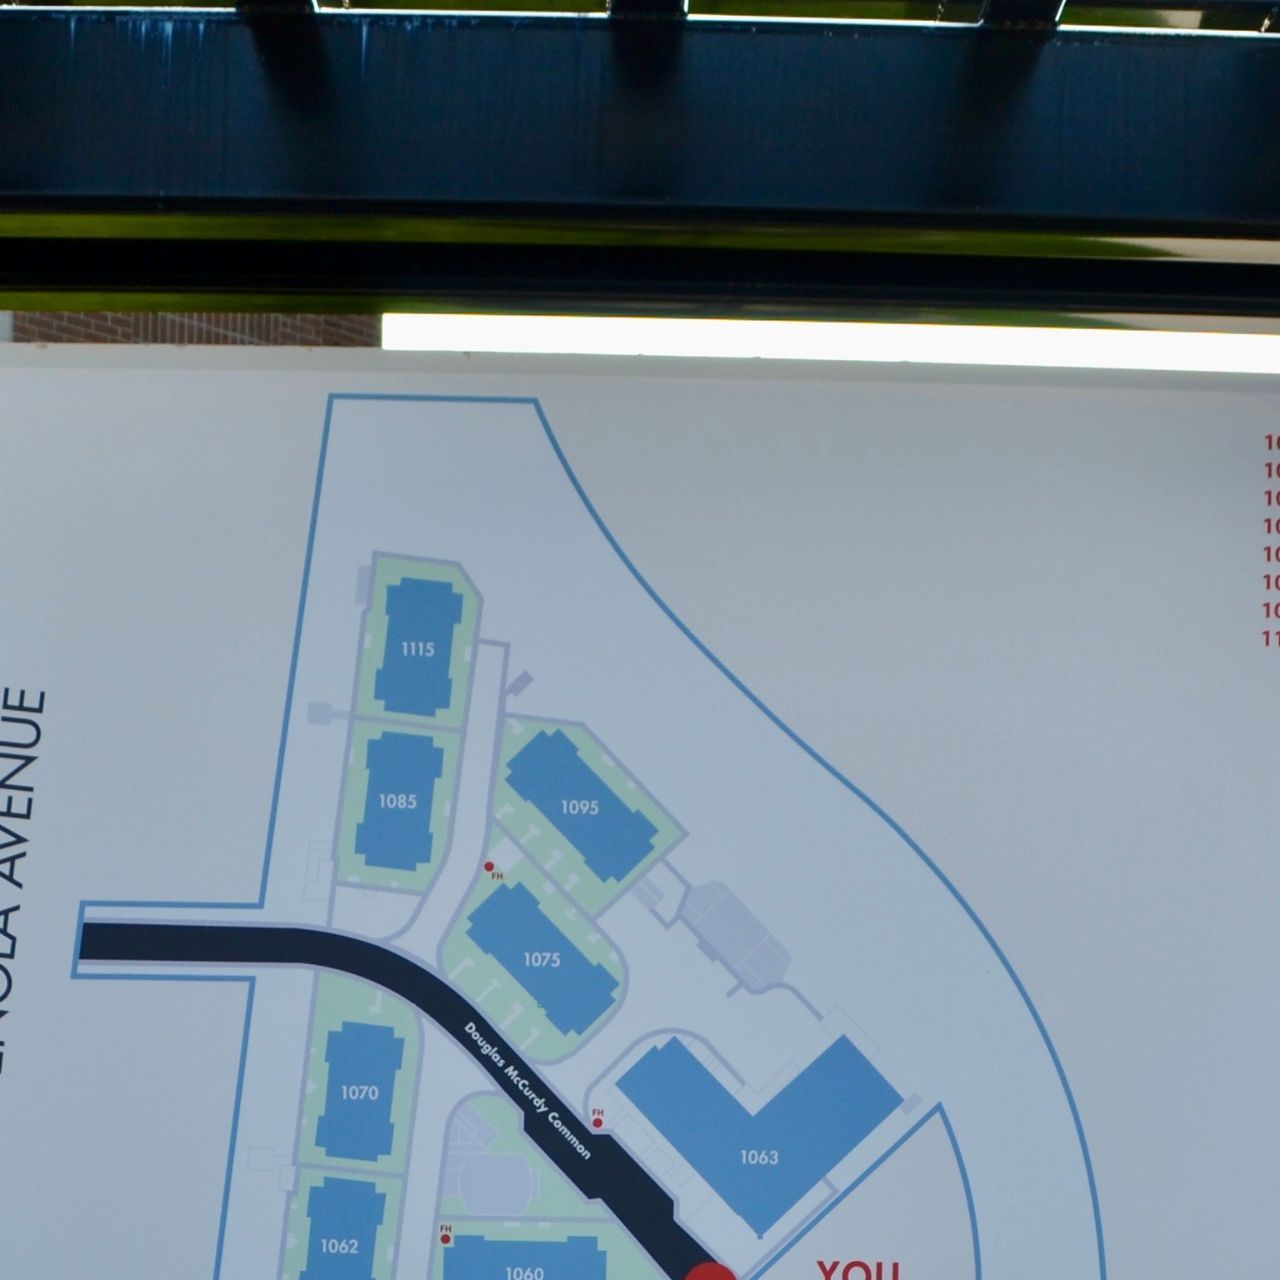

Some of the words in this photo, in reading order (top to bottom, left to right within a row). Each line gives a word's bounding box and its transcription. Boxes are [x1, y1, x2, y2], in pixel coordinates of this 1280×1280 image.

[402, 642, 435, 657] 1115
[379, 794, 418, 809] 1085
[561, 800, 600, 815] 1095
[491, 872, 504, 880] FH
[524, 952, 562, 967] 1075
[341, 1085, 380, 1100] 1070
[464, 1021, 506, 1068] Douglas
[504, 1065, 549, 1114] McCurdy
[547, 1111, 592, 1161] Common
[592, 1108, 604, 1117] FH
[740, 1150, 780, 1165] 1063
[440, 1224, 452, 1233] FH
[320, 1239, 359, 1254] 1062
